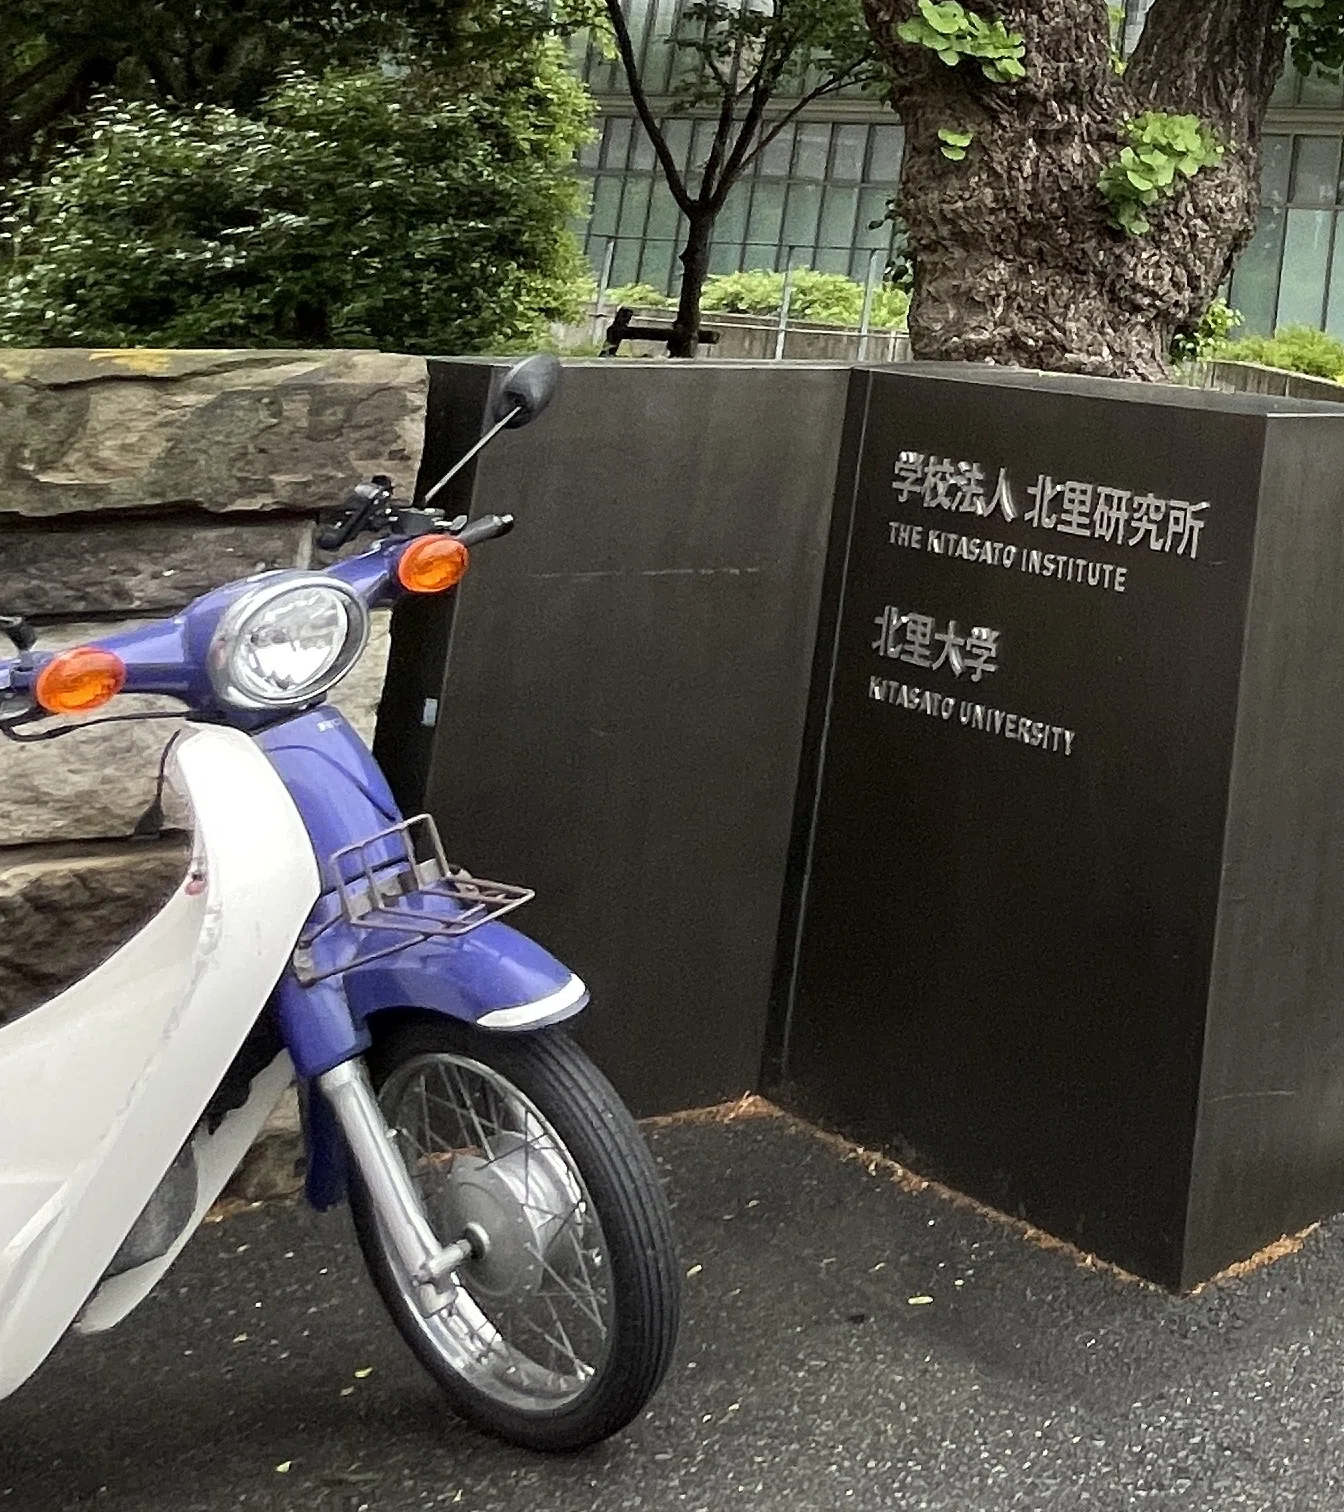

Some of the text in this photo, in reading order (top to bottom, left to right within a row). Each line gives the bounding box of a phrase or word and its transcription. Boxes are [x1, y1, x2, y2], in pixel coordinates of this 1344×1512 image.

[891, 451, 1212, 559] 学校法人 北里研究所
[888, 521, 1129, 593] THE KITASATO INSTITUTE
[871, 604, 1001, 683] 北里大学
[868, 675, 1076, 756] KITASATO UNIVERSITY
